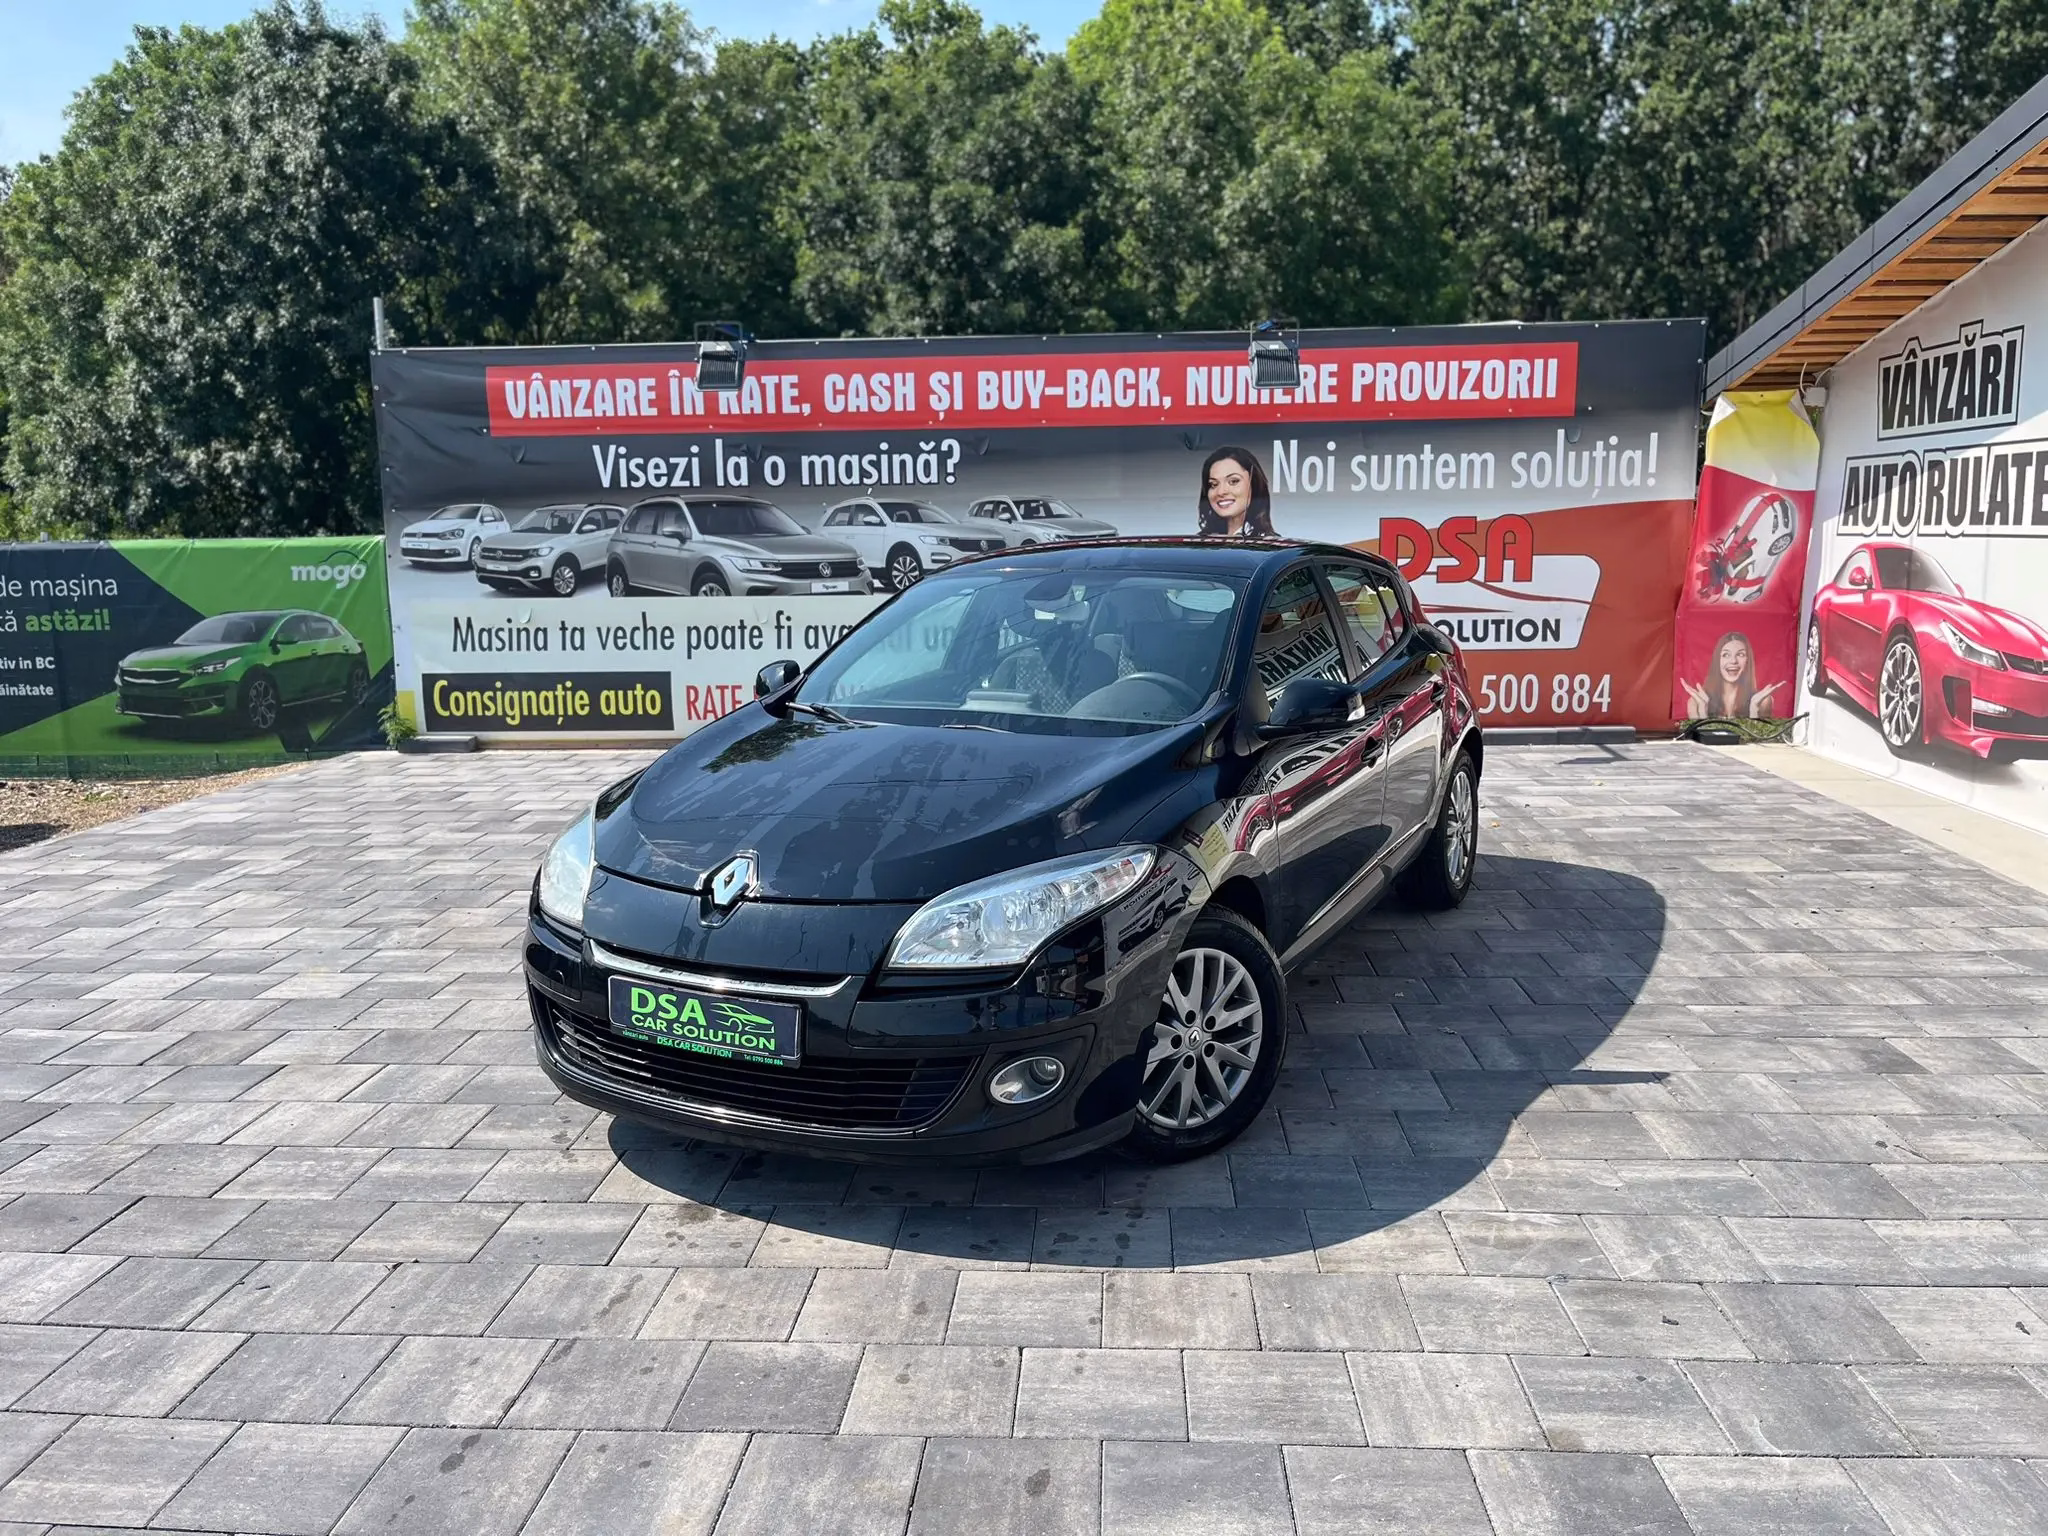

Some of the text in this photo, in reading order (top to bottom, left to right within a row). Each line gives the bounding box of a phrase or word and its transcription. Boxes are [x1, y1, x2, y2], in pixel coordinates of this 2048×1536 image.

[504, 372, 658, 419] VÂNZARE
[668, 369, 705, 416] ÎN
[823, 372, 916, 414] CASH
[928, 370, 964, 422] ȘI
[977, 367, 1173, 411] BUY-BACK,
[1351, 358, 1559, 403] PROVIZORII
[1882, 333, 2019, 431] VÂNZĂRI
[591, 438, 962, 495] Visezi la o mașină?
[1272, 428, 1659, 499] Noi suntem soluția!
[1842, 460, 1918, 528] AUTO
[1378, 513, 1534, 584] DSA
[30, 573, 118, 602] mașina
[290, 564, 368, 589] mogo
[25, 608, 111, 632] astăzi!
[452, 616, 549, 653] Masina
[558, 620, 586, 652] ta
[596, 611, 676, 652] veche
[686, 618, 764, 661] poate
[774, 610, 793, 651] fi
[1433, 618, 1562, 644] OLUTION
[18, 656, 33, 670] in
[35, 656, 56, 670] BC
[432, 679, 591, 726] Consignație
[599, 683, 662, 717] auto
[1479, 672, 1612, 715] 500 884
[630, 986, 708, 1026] DSA
[630, 1014, 776, 1051] CAR SOLUTION
[657, 1035, 733, 1058] DSA CAR SOLUTION
